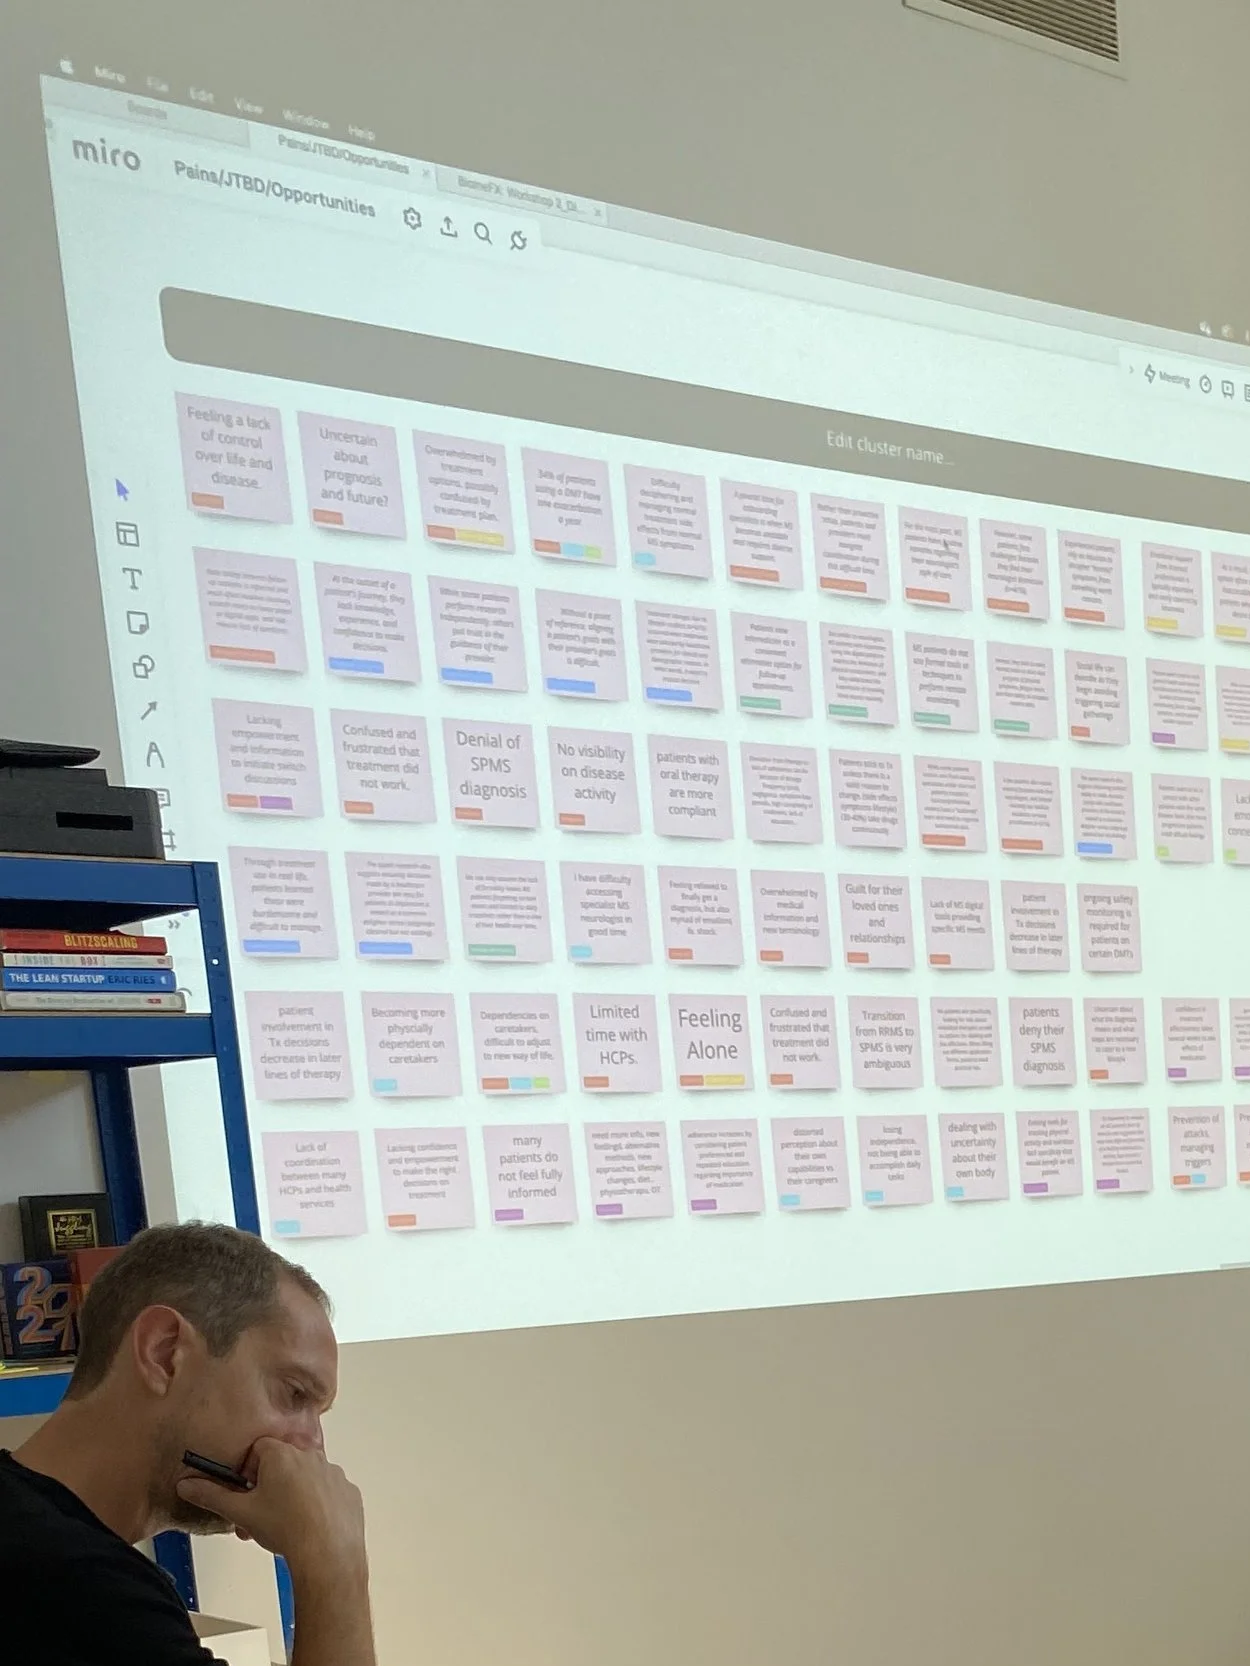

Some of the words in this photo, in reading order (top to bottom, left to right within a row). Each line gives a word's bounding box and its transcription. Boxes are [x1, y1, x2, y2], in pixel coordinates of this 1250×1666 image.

[72, 137, 141, 172] miro
[174, 160, 376, 218] Pains/JTBD/Opportunities
[1159, 370, 1190, 389] Meeting
[187, 406, 233, 428] Feeling
[236, 415, 244, 426] a
[246, 415, 272, 431] lack
[201, 429, 215, 441] of
[217, 431, 263, 449] control
[319, 427, 378, 447] Uncertain
[826, 429, 853, 450] Edit
[857, 436, 904, 458] cluster
[195, 450, 223, 463] over
[226, 451, 246, 468] life
[249, 455, 273, 471] and
[333, 450, 368, 466] about
[324, 468, 383, 487] prognosis
[320, 487, 344, 500] and
[346, 488, 389, 508] future?
[343, 724, 394, 739] Confused
[397, 728, 417, 741] and
[456, 731, 504, 749] Denial
[507, 733, 522, 750] of
[344, 740, 397, 756] frustrated
[399, 745, 421, 758] that
[557, 743, 576, 755] No
[577, 744, 626, 762] visibility
[471, 757, 512, 773] SPMS
[656, 751, 696, 765] patients
[698, 753, 719, 766] with
[347, 759, 401, 773] treatment
[403, 762, 420, 774] did
[561, 766, 578, 777] on
[580, 765, 625, 781] disease
[660, 769, 680, 781] oral
[681, 769, 719, 784] therapy
[360, 778, 379, 789] not
[460, 780, 528, 801] diagnosis
[574, 787, 616, 804] activity
[669, 789, 685, 799] are
[687, 790, 713, 800] more
[668, 804, 717, 818] compliant
[845, 883, 866, 897] Guilt
[868, 884, 880, 896] for
[882, 884, 903, 896] their
[852, 900, 876, 912] loved
[878, 902, 900, 912] ones
[868, 917, 886, 928] and
[64, 934, 138, 948] BLITZSCALING
[850, 933, 906, 946] relationships
[80, 956, 101, 966] BOX
[8, 973, 29, 983] THE
[32, 974, 59, 983] LEAN
[61, 974, 105, 984] STARTUP
[108, 976, 130, 984] ERIC
[133, 976, 155, 984] RIES
[372, 1007, 418, 1020] Becoming
[420, 1008, 446, 1018] more
[590, 1004, 640, 1019] Limited
[769, 1007, 809, 1018] Confused
[810, 1008, 827, 1018] and
[861, 1011, 906, 1022] Transition
[1023, 1008, 1060, 1020] patients
[678, 1008, 742, 1033] Feeling
[769, 1023, 811, 1033] frustrated
[813, 1023, 830, 1033] that
[855, 1026, 877, 1037] from
[879, 1026, 903, 1037] RRMS
[1019, 1026, 1043, 1037] deny
[1044, 1025, 1064, 1037] their
[586, 1028, 616, 1042] time
[619, 1028, 647, 1042] with
[379, 1038, 428, 1050] dependent
[431, 1040, 445, 1048] on
[772, 1038, 814, 1048] treatment
[815, 1038, 830, 1047] did
[859, 1042, 884, 1053] SPMS
[894, 1044, 913, 1055] very
[1030, 1042, 1056, 1054] SPMS
[687, 1041, 739, 1060] Alone
[389, 1054, 439, 1064] caretakers
[600, 1051, 638, 1065] HCPs.
[783, 1053, 797, 1062] not
[863, 1059, 911, 1071] ambiguous
[1023, 1060, 1065, 1073] diagnosis
[1172, 1114, 1209, 1125] Prevention
[947, 1122, 978, 1134] dealing
[980, 1121, 997, 1132] with
[295, 1142, 316, 1152] Lack
[513, 1135, 542, 1148] many
[950, 1137, 996, 1149] uncertainty
[1180, 1143, 1214, 1155] managing
[285, 1156, 340, 1167] coordination
[500, 1151, 541, 1165] patients
[543, 1151, 558, 1163] do
[952, 1153, 976, 1163] about
[977, 1152, 996, 1163] their
[1185, 1158, 1211, 1168] triggers
[282, 1171, 320, 1182] between
[322, 1170, 346, 1182] many
[499, 1171, 517, 1182] not
[519, 1169, 539, 1181] feel
[541, 1169, 563, 1183] fully
[956, 1169, 973, 1179] own
[975, 1167, 995, 1179] body
[280, 1184, 303, 1196] HCPs
[304, 1183, 322, 1194] and
[323, 1182, 352, 1193] health
[508, 1185, 557, 1198] informed
[300, 1199, 335, 1209] services
